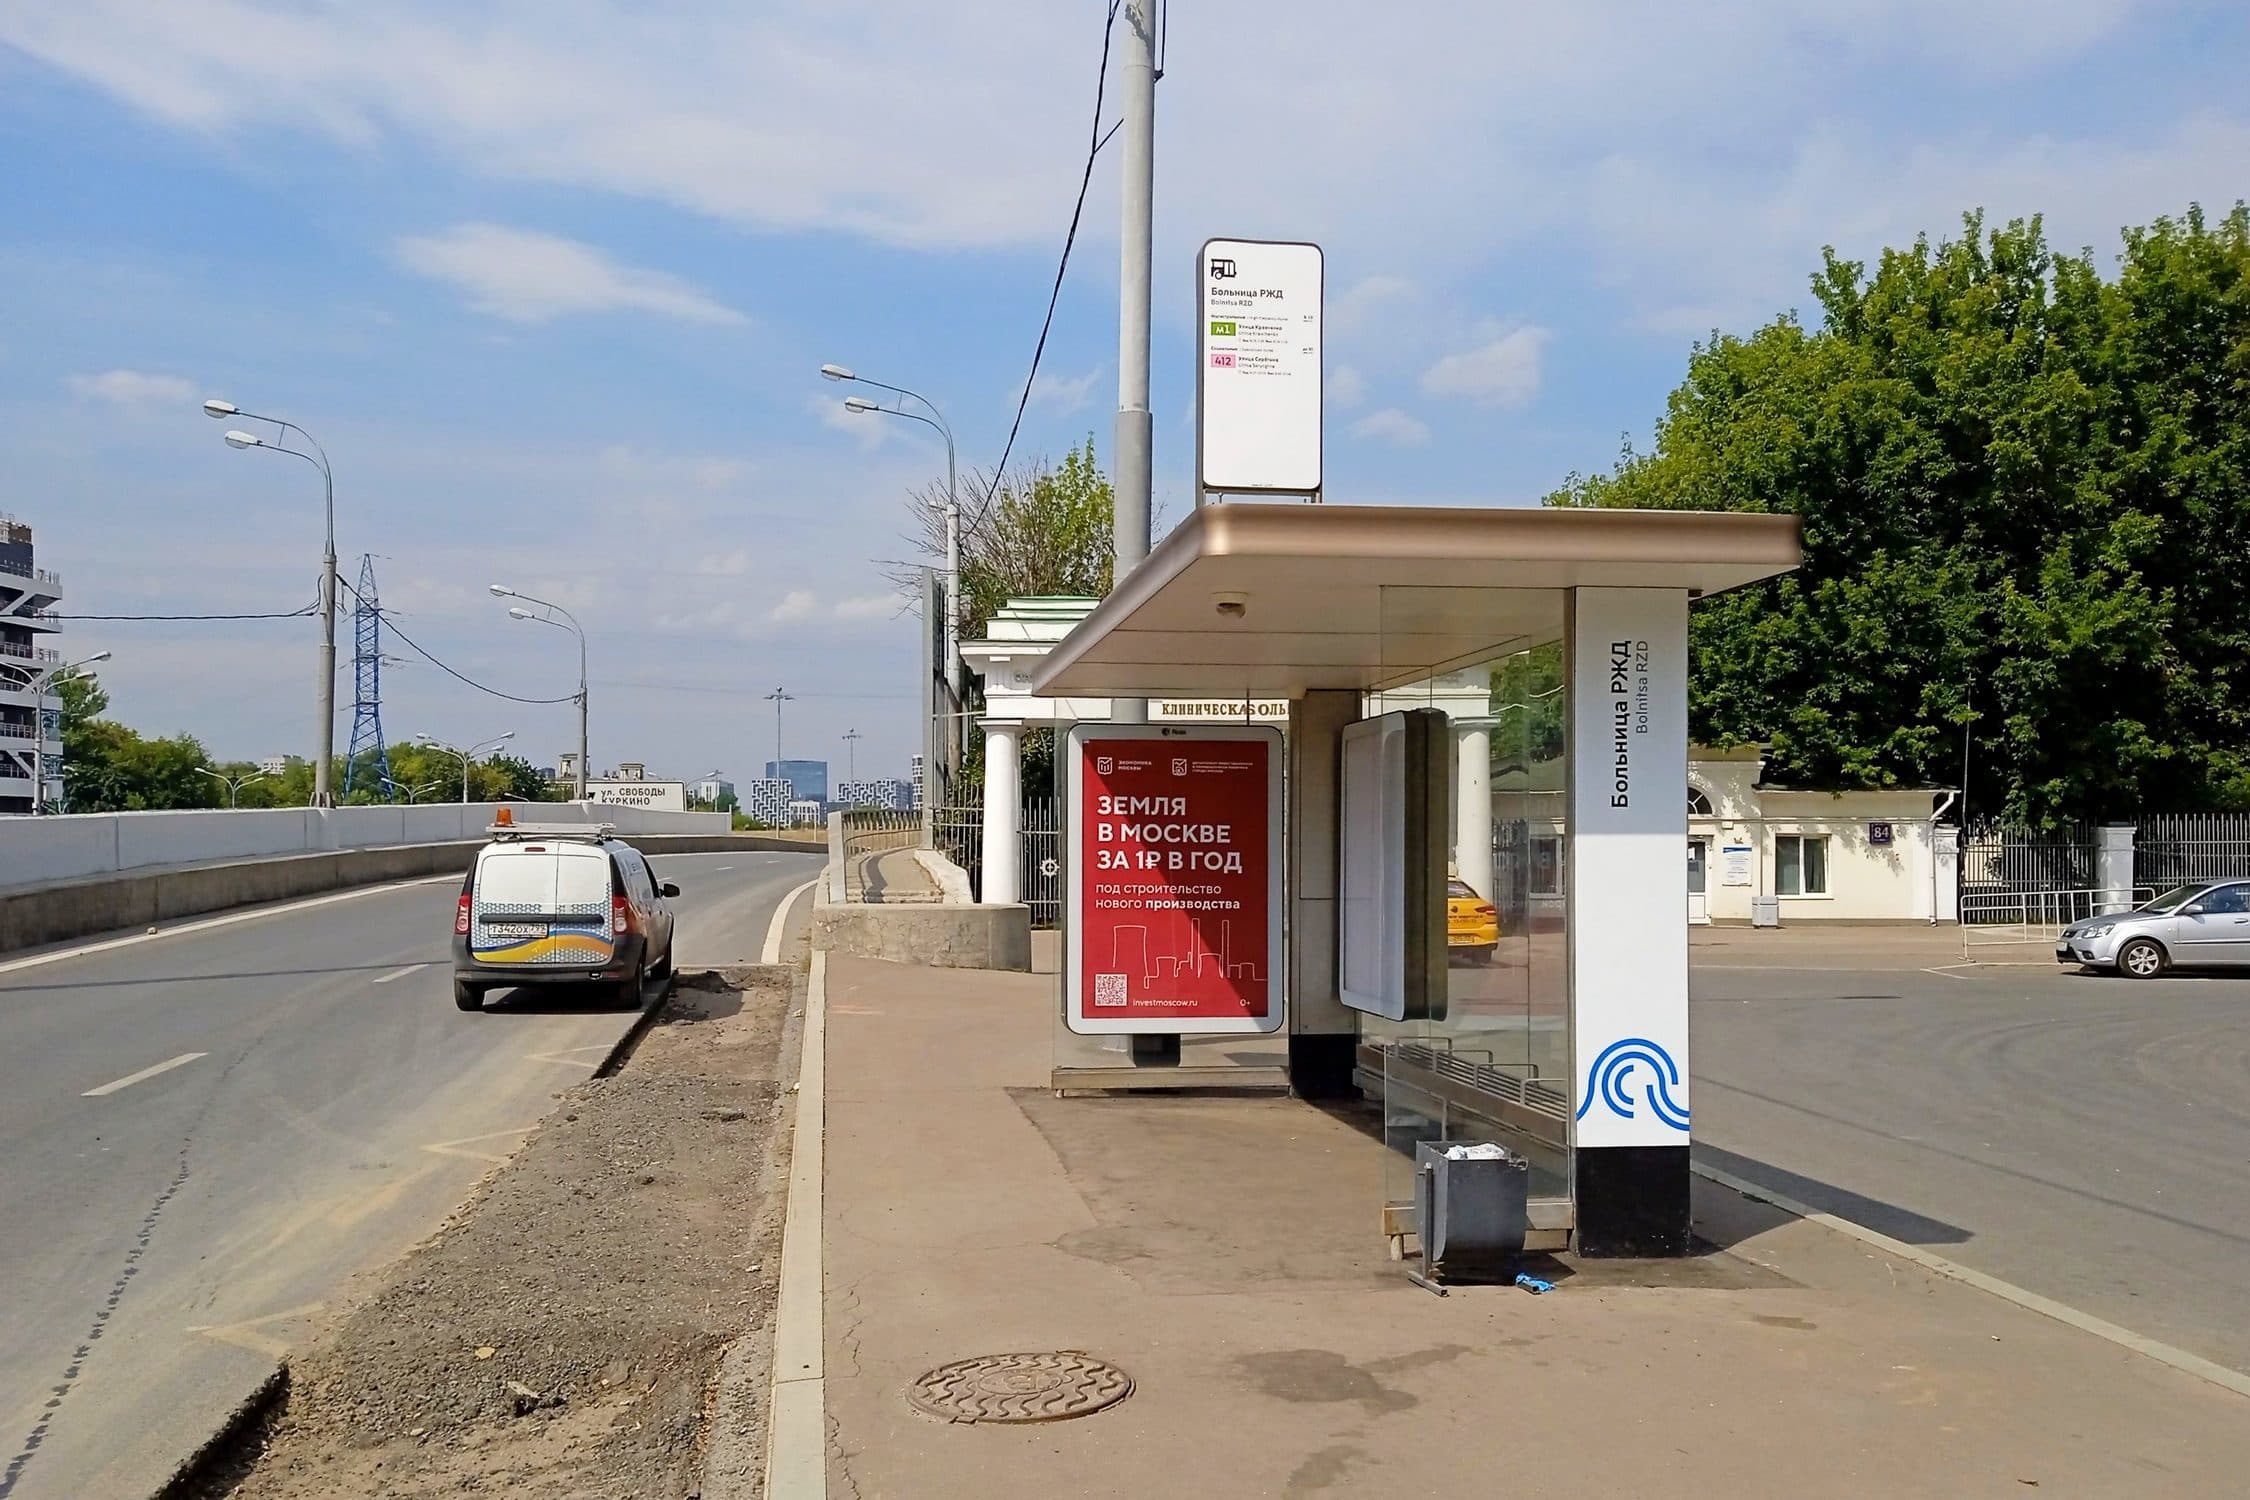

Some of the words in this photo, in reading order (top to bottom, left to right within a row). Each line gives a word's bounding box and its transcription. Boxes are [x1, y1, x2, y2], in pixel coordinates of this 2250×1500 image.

[1211, 287, 1257, 298] Больница
[1260, 289, 1284, 300] РЖД
[1214, 356, 1232, 367] 412
[1636, 640, 1649, 672] RZD
[1611, 640, 1632, 694] РЖД
[1636, 677, 1648, 734] Bolnitsa
[1611, 701, 1630, 808] Больница
[619, 788, 666, 797] СВОБОДЫ
[602, 797, 650, 805] КУРКИНО
[1097, 796, 1186, 816] ЗЕМЛЯ
[1097, 824, 1114, 842] В
[1120, 824, 1231, 843] МОСКВЕ
[1874, 827, 1889, 838] 84
[1097, 851, 1130, 870] ЗА
[1168, 853, 1183, 870] В
[1191, 853, 1242, 874] ГОД
[1096, 884, 1121, 897] под
[1123, 884, 1222, 897] строительство
[1096, 899, 1142, 909] нового
[1145, 899, 1240, 910] производства
[1133, 998, 1198, 1007] investmoscow.ru
[1240, 998, 1251, 1007] 0+
